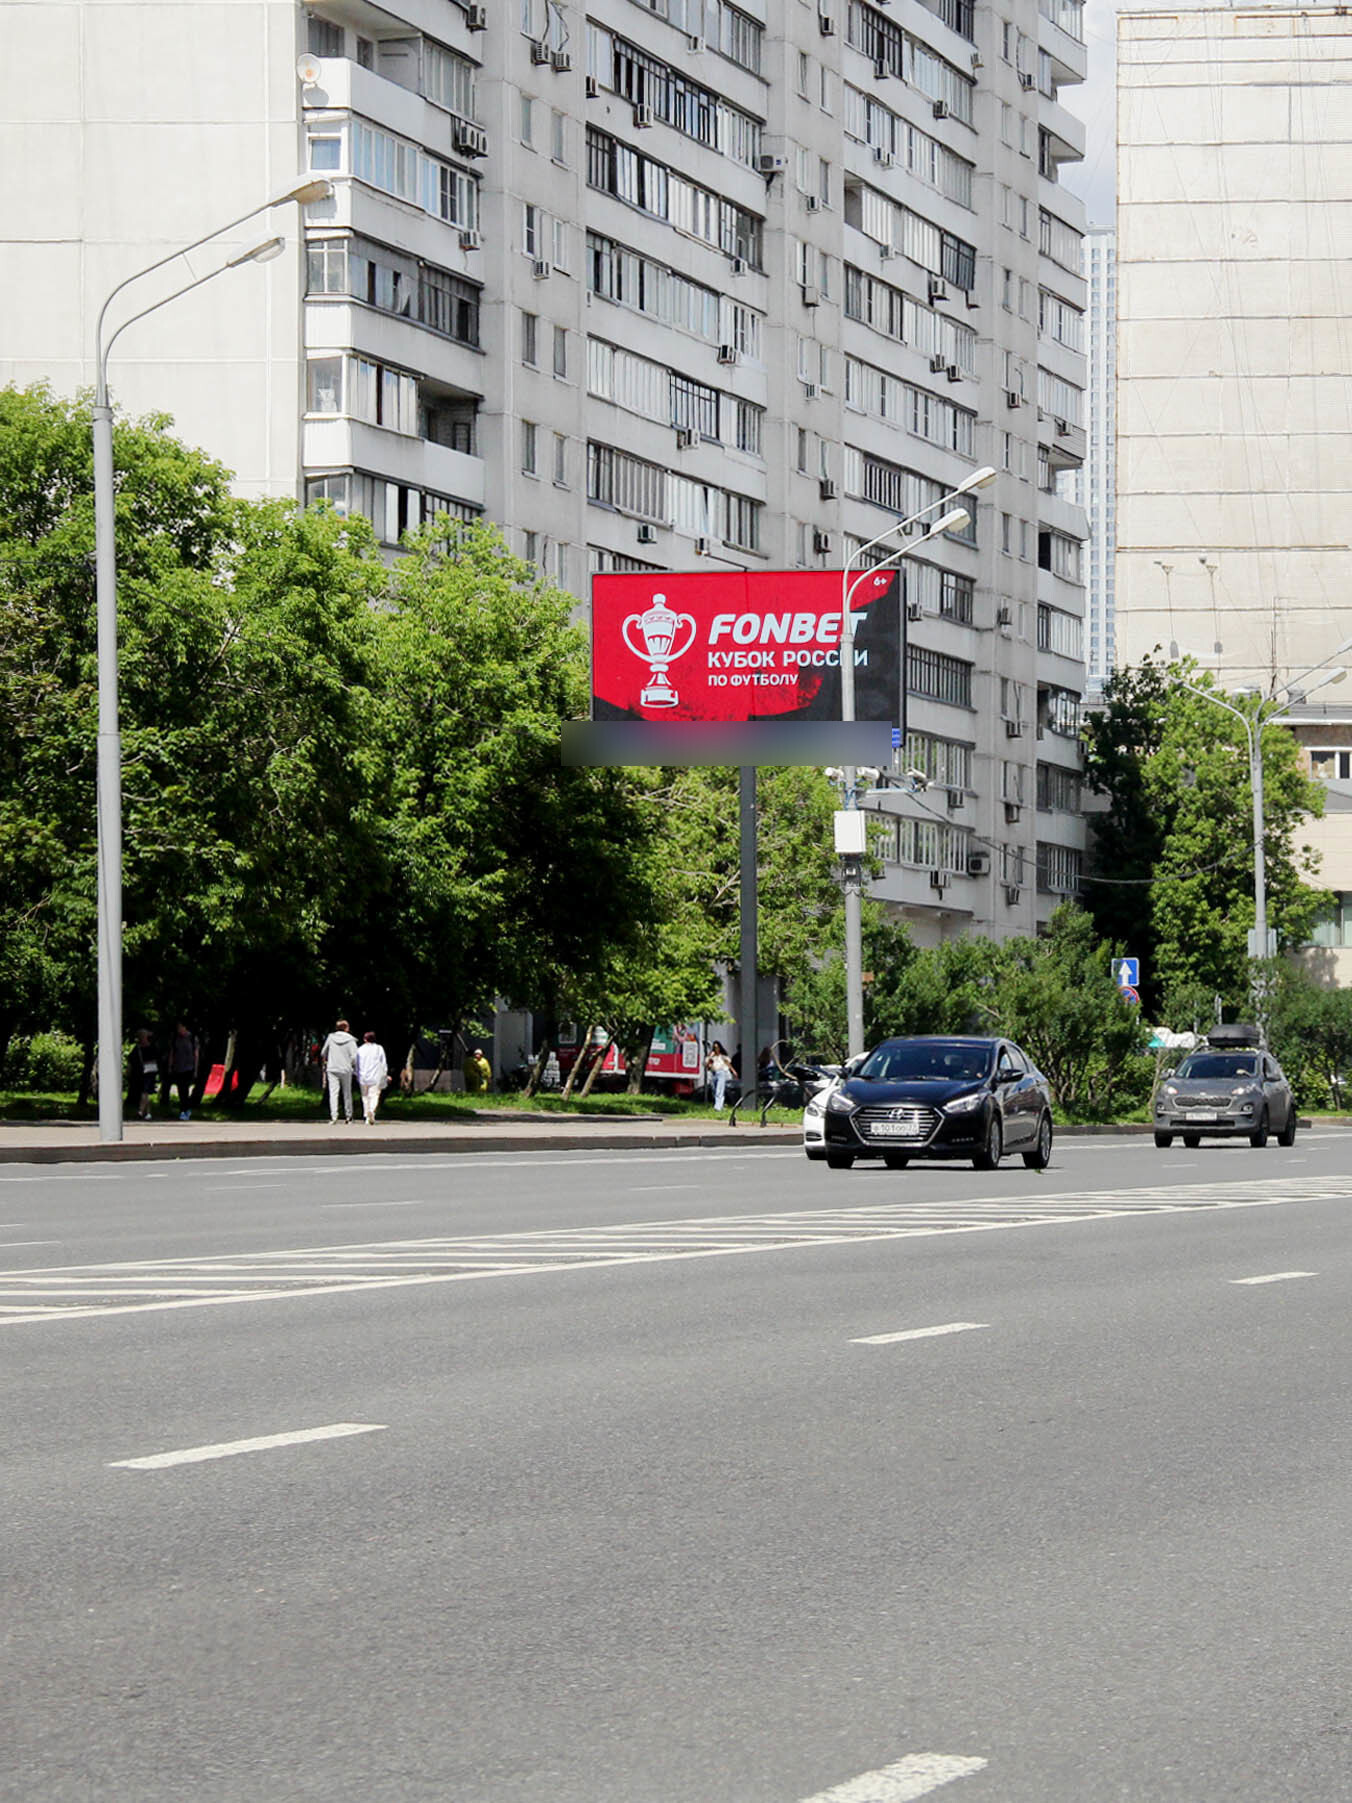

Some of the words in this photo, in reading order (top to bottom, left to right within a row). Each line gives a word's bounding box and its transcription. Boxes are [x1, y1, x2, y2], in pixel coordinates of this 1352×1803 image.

[874, 577, 887, 587] 6+
[708, 612, 868, 645] FONBET
[708, 651, 775, 668] КУБОК
[708, 675, 727, 687] ПО
[730, 674, 799, 687] ФУТБОЛУ
